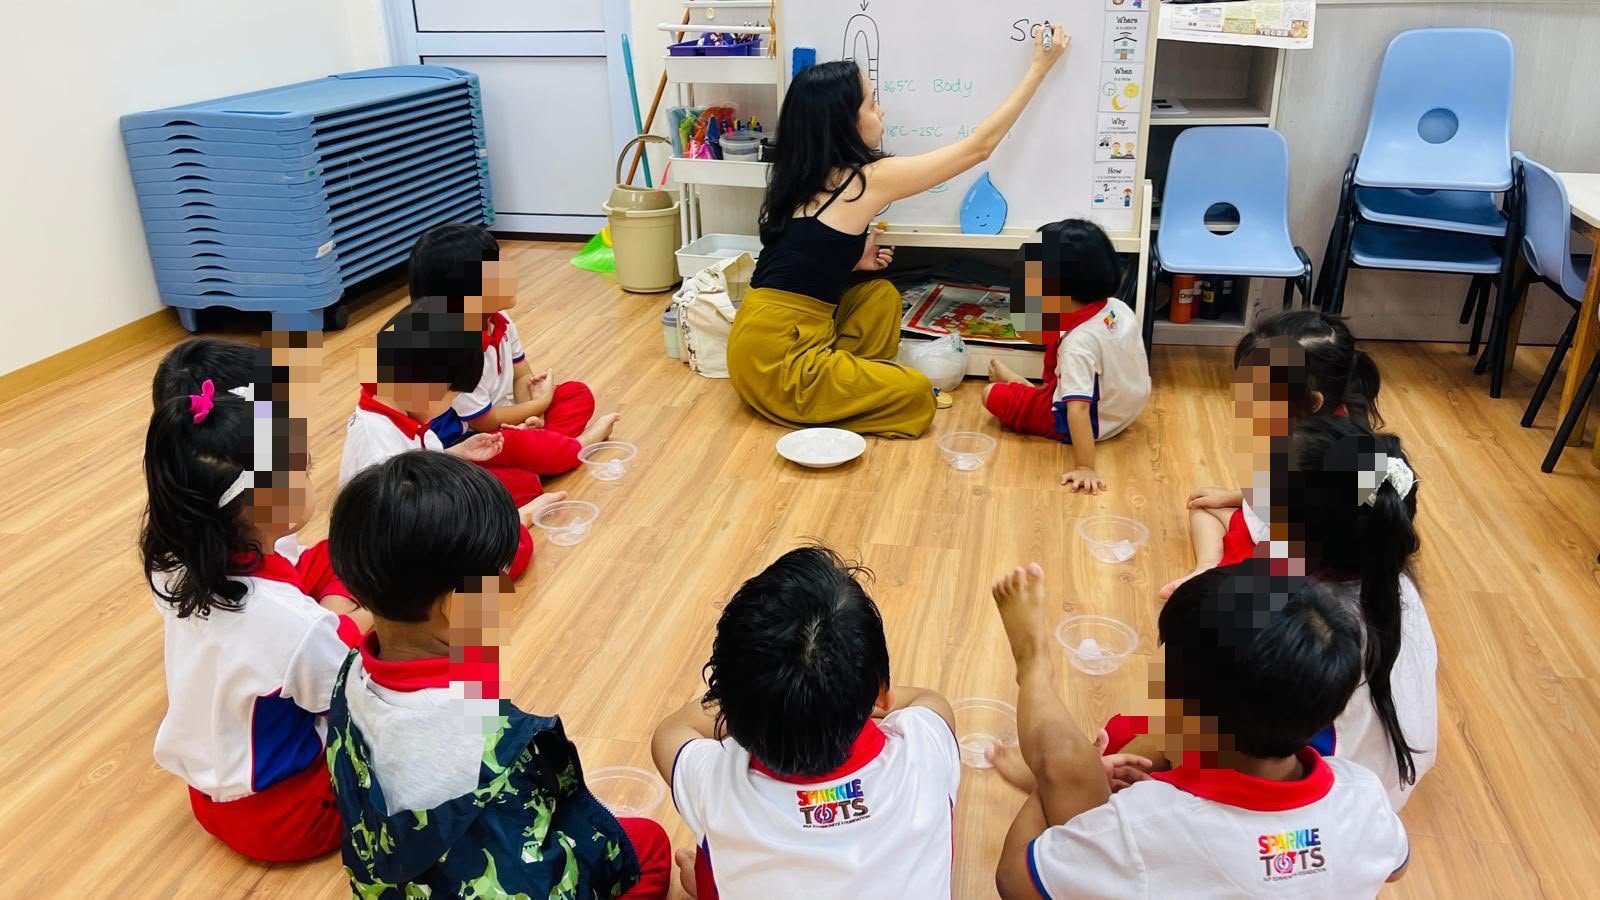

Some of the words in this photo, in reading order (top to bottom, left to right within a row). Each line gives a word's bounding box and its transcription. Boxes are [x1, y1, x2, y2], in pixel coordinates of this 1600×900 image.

[1116, 16, 1138, 24] Where
[932, 77, 974, 98] Body
[1111, 117, 1127, 127] Why
[1107, 167, 1122, 175] How
[796, 778, 864, 807] SPARKLE
[799, 797, 869, 825] TOTS
[1258, 828, 1322, 854] SPARKLE
[1259, 846, 1325, 877] TOTS
